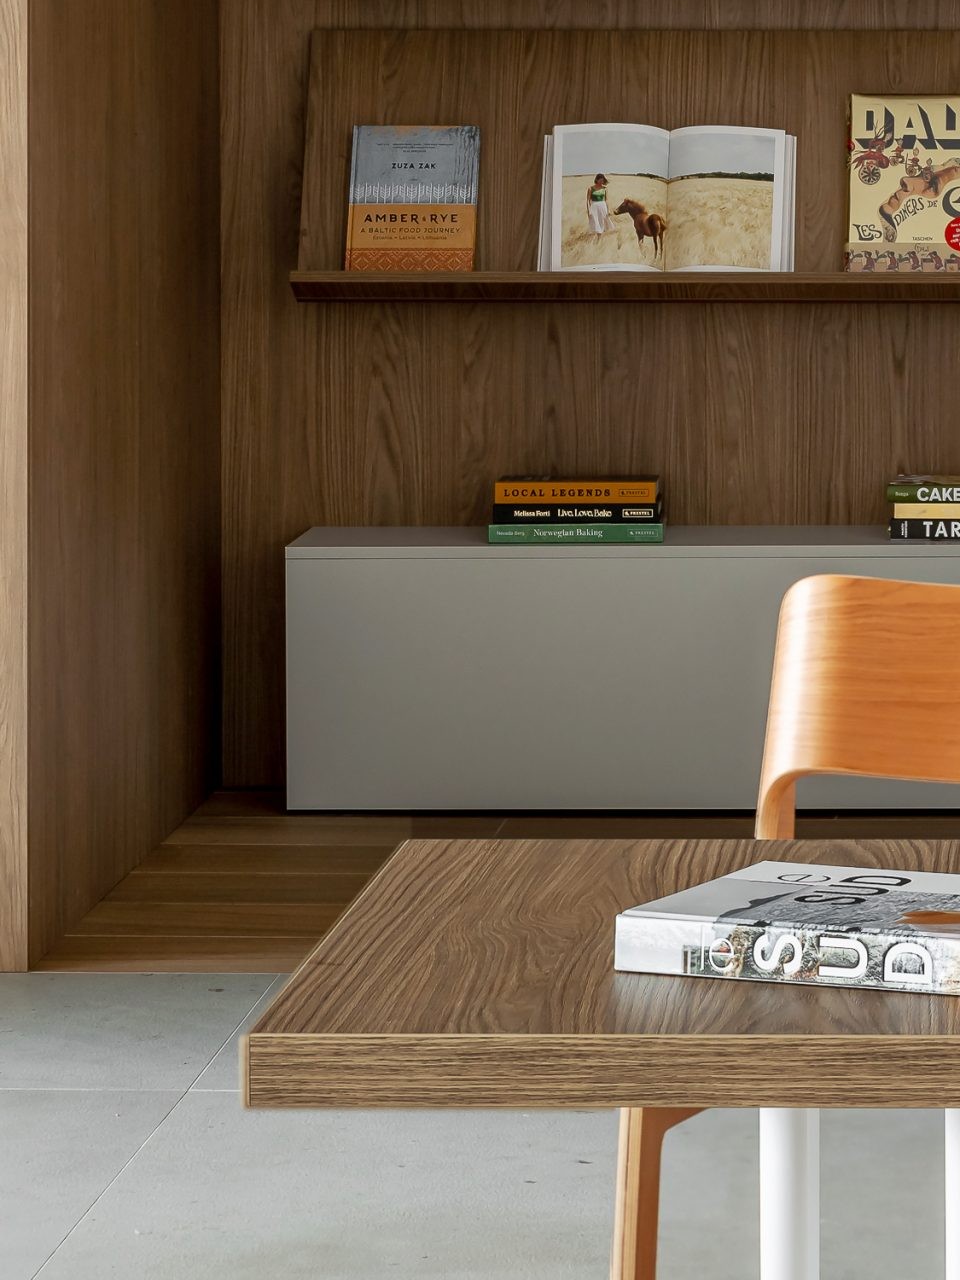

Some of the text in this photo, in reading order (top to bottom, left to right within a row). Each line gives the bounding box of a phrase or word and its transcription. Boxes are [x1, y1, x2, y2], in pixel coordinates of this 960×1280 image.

[364, 213, 458, 224] AMBER RYE
[852, 223, 883, 241] LES
[927, 200, 938, 208] DE
[503, 488, 545, 497] LOCAL
[551, 488, 611, 497] LEGENDS
[594, 509, 612, 517] Bake
[533, 529, 574, 538] Norwegian
[576, 528, 603, 538] Baking
[753, 933, 934, 984] SUD
